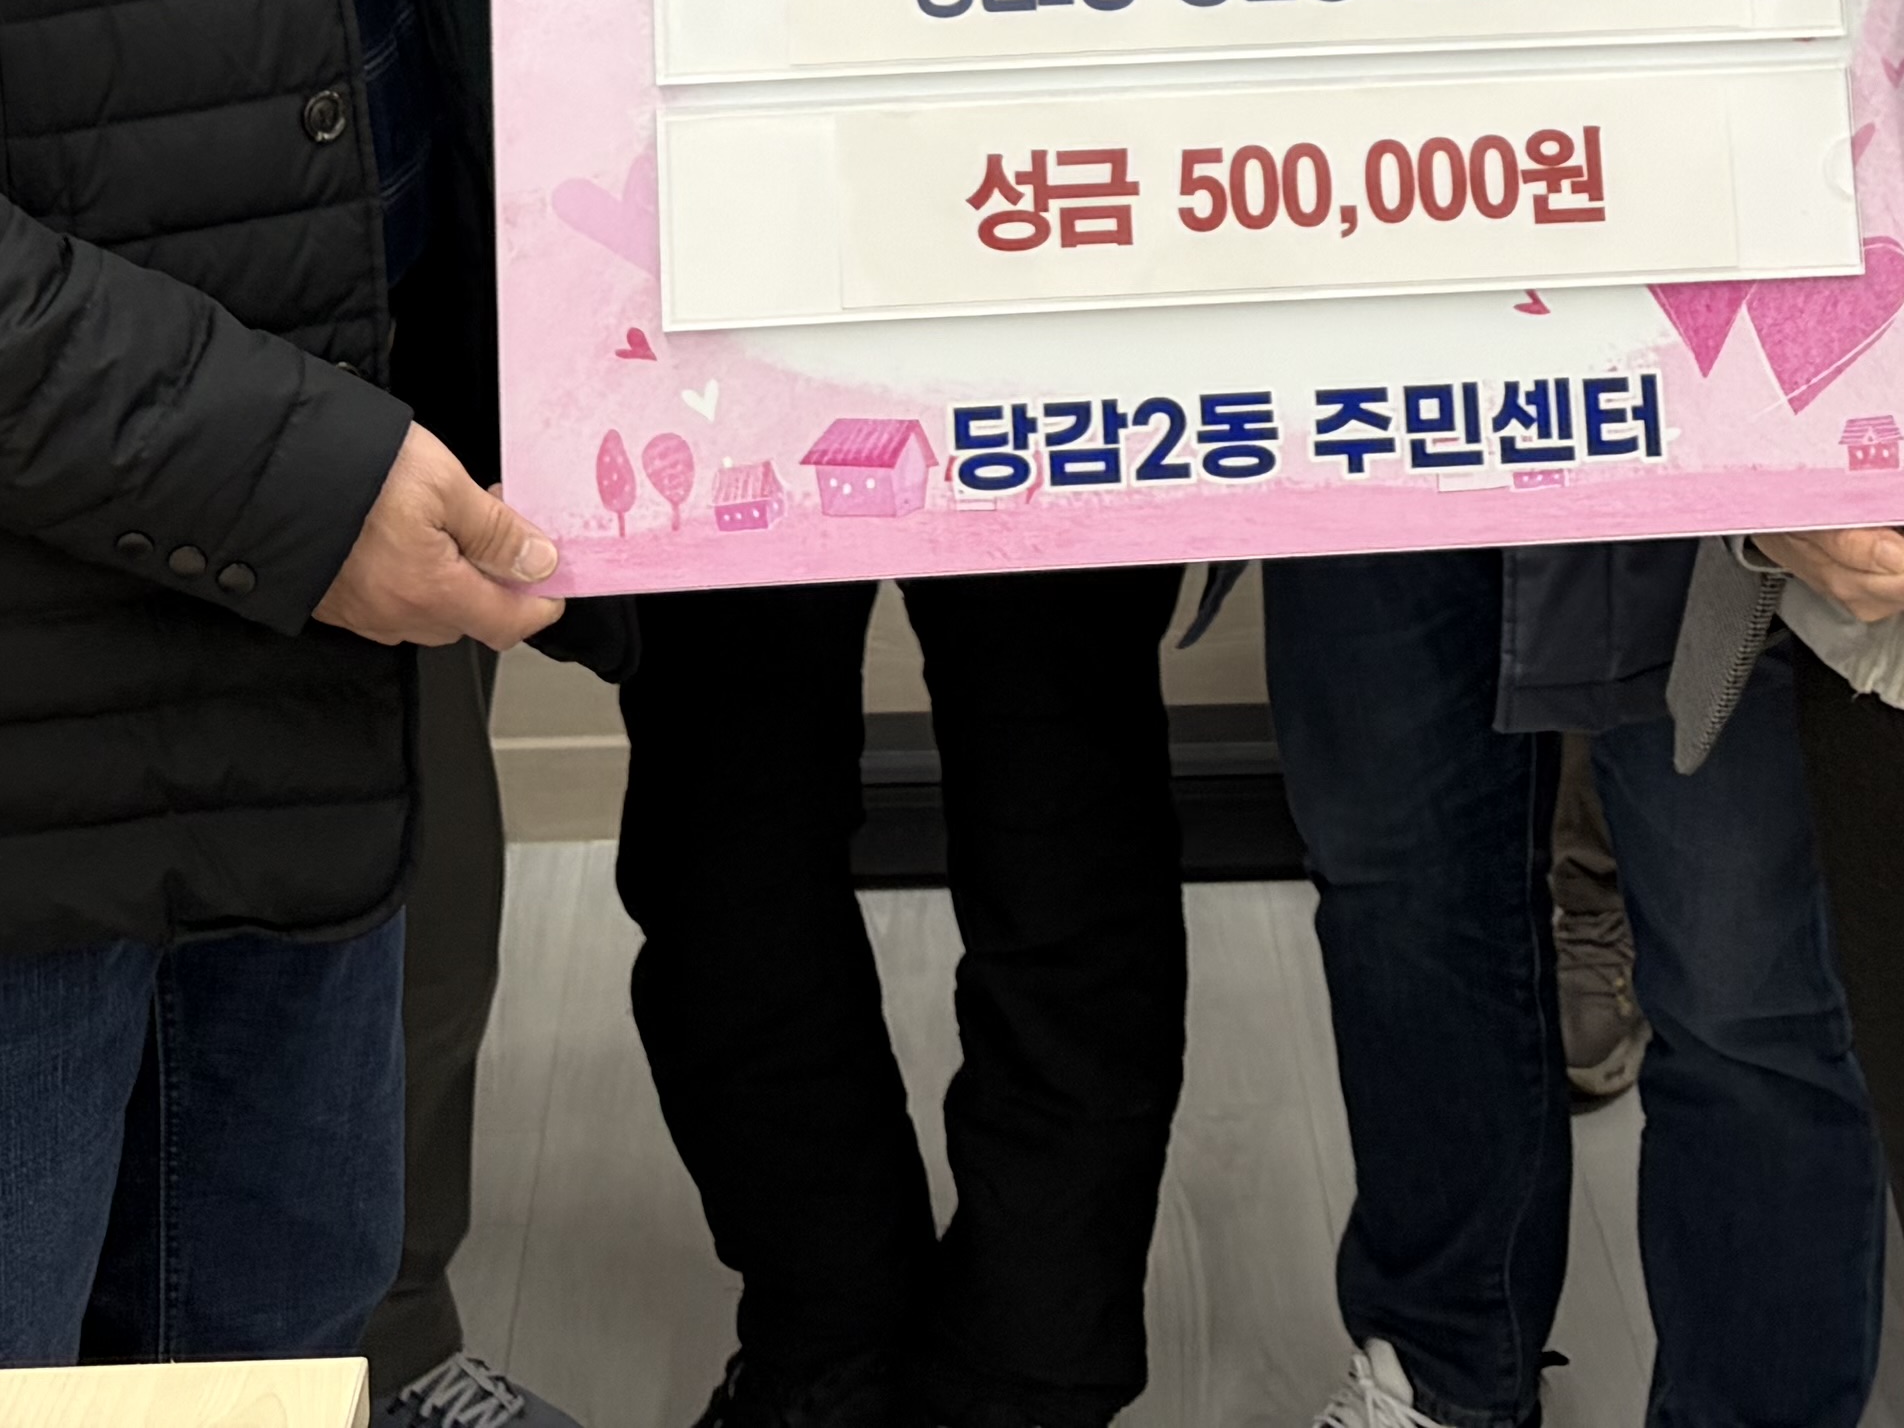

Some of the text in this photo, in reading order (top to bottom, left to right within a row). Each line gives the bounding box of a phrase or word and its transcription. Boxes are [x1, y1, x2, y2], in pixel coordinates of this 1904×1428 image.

[964, 125, 1607, 253] 성금 500,000원
[952, 374, 1663, 492] 당감2동 주민센터
